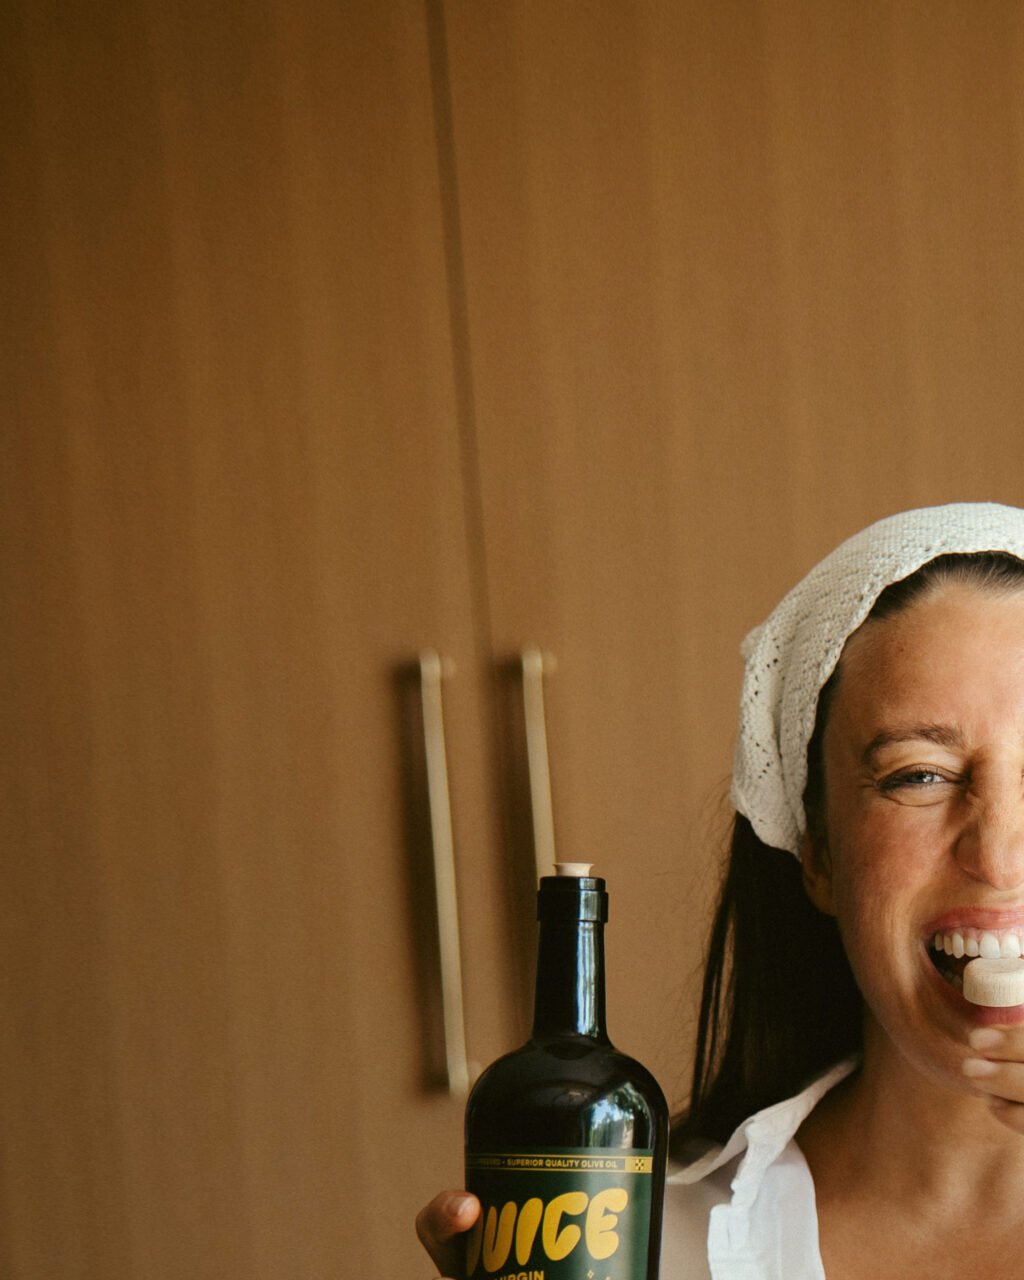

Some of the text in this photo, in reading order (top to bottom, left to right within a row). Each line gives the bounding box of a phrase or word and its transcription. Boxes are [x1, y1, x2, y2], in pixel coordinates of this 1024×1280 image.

[507, 1158, 544, 1168] SUPERIOR
[545, 1158, 579, 1168] QUALITY
[581, 1158, 604, 1169] OLIVE
[606, 1159, 618, 1169] OIL
